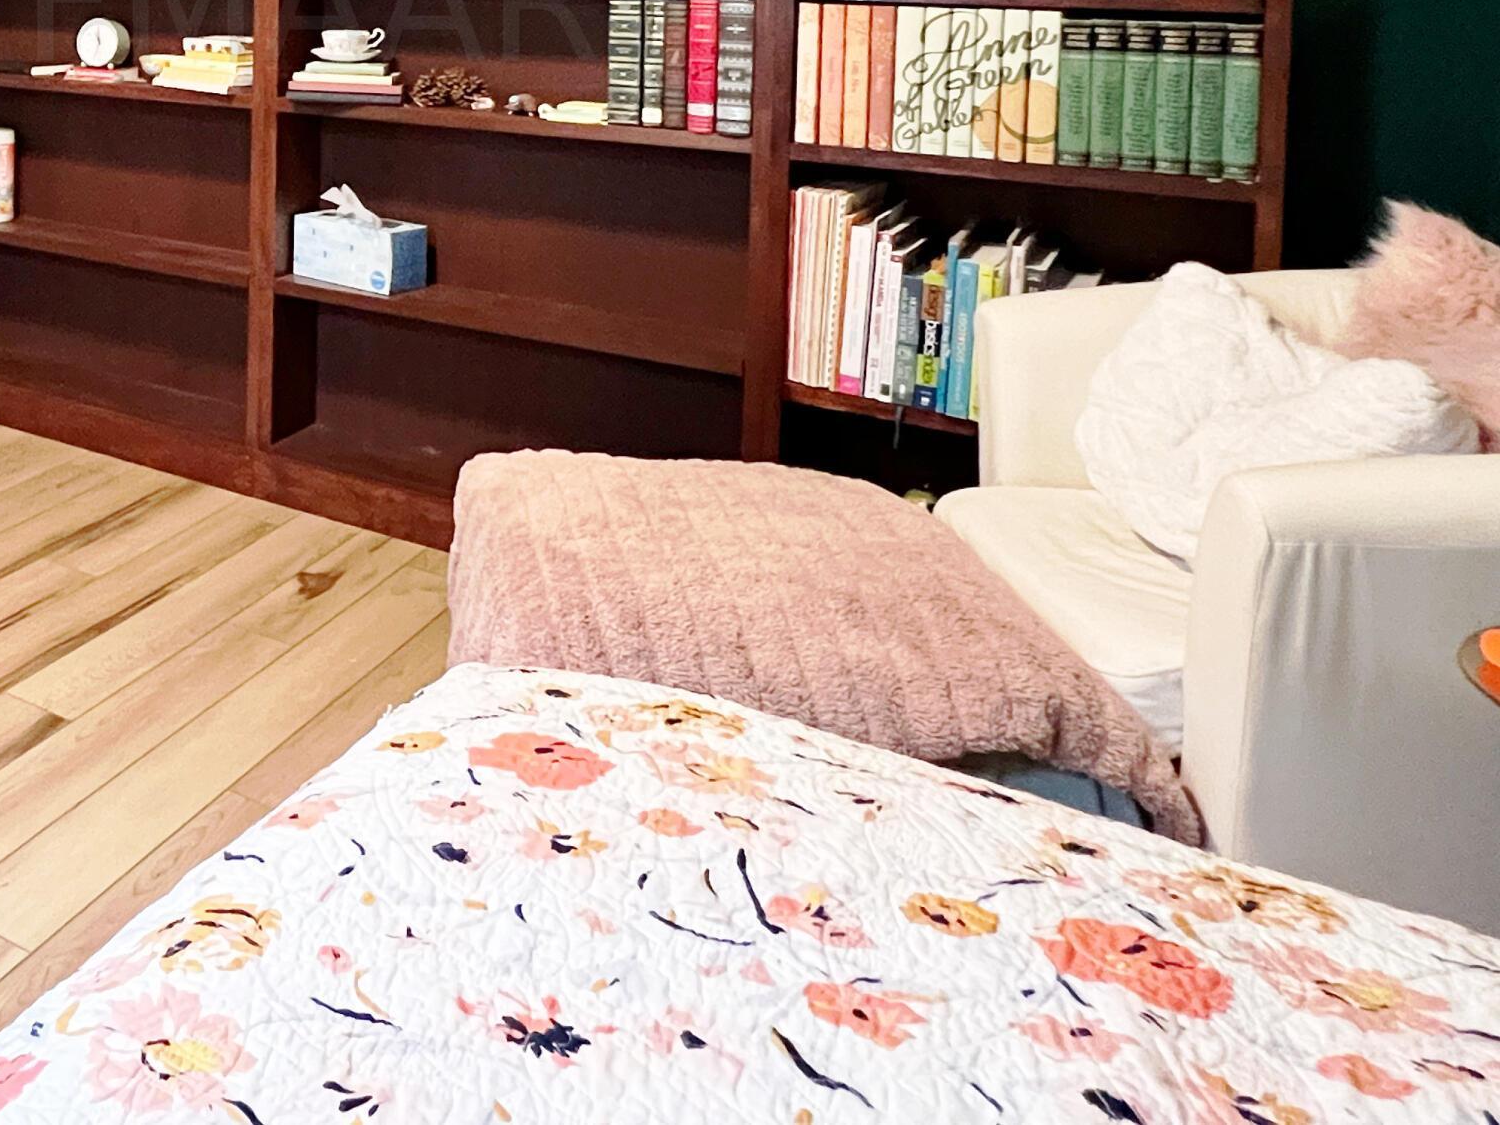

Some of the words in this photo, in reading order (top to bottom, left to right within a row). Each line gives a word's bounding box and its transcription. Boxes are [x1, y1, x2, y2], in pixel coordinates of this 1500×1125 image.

[903, 10, 1058, 87] Anne
[893, 82, 924, 122] of
[933, 57, 1053, 104] Green
[894, 97, 983, 151] Gables
[923, 320, 940, 357] basics
